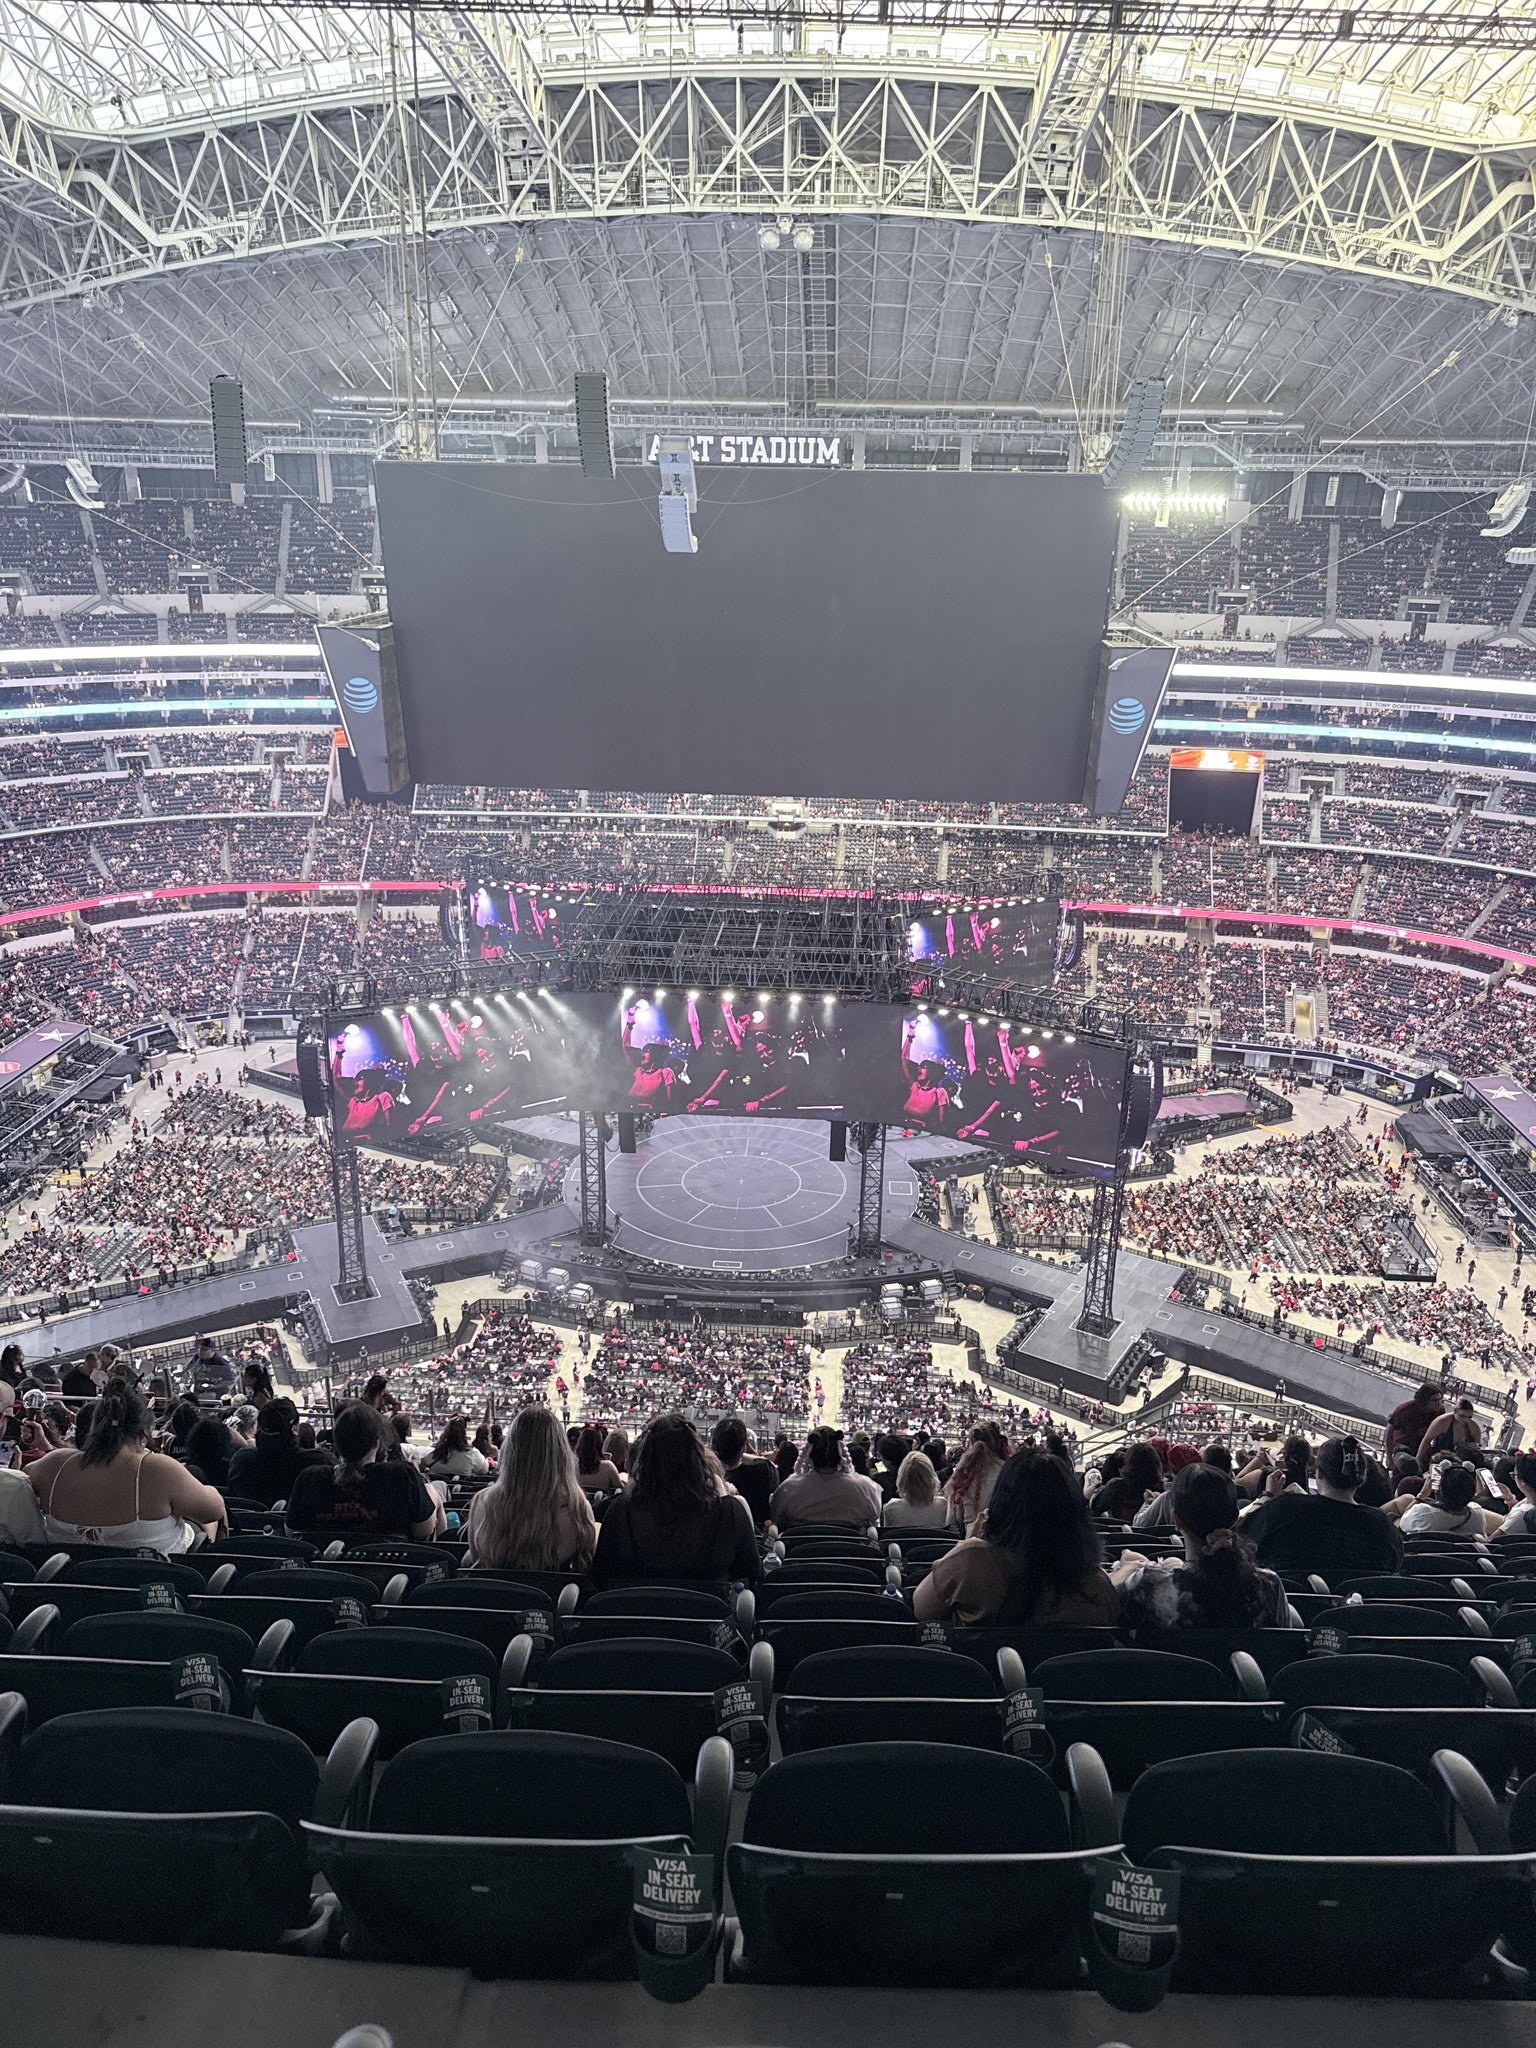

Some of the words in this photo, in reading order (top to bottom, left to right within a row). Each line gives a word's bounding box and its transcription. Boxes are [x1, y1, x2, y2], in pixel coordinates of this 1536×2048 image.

[721, 436, 840, 464] STADIUM
[186, 1657, 206, 1666] VISA
[183, 1665, 211, 1676] IN-SEAT
[180, 1674, 215, 1686] DELIVERY
[456, 1678, 477, 1686] VISA
[453, 1686, 481, 1696] IN-SEAT
[726, 1686, 746, 1695] VISA
[1010, 1692, 1027, 1703] VISA
[450, 1695, 484, 1707] DELIVERY
[723, 1693, 752, 1707] IN-SEAT
[721, 1701, 756, 1718] DELIVERY
[1006, 1709, 1037, 1727] DELIVERY
[653, 1858, 687, 1872] VISA
[648, 1869, 696, 1888] IN-SEAT
[1118, 1868, 1154, 1886] VISA
[643, 1884, 701, 1904] DELIVERY
[1112, 1880, 1162, 1901] IN-SEAT
[1106, 1893, 1167, 1916] DELIVERY
